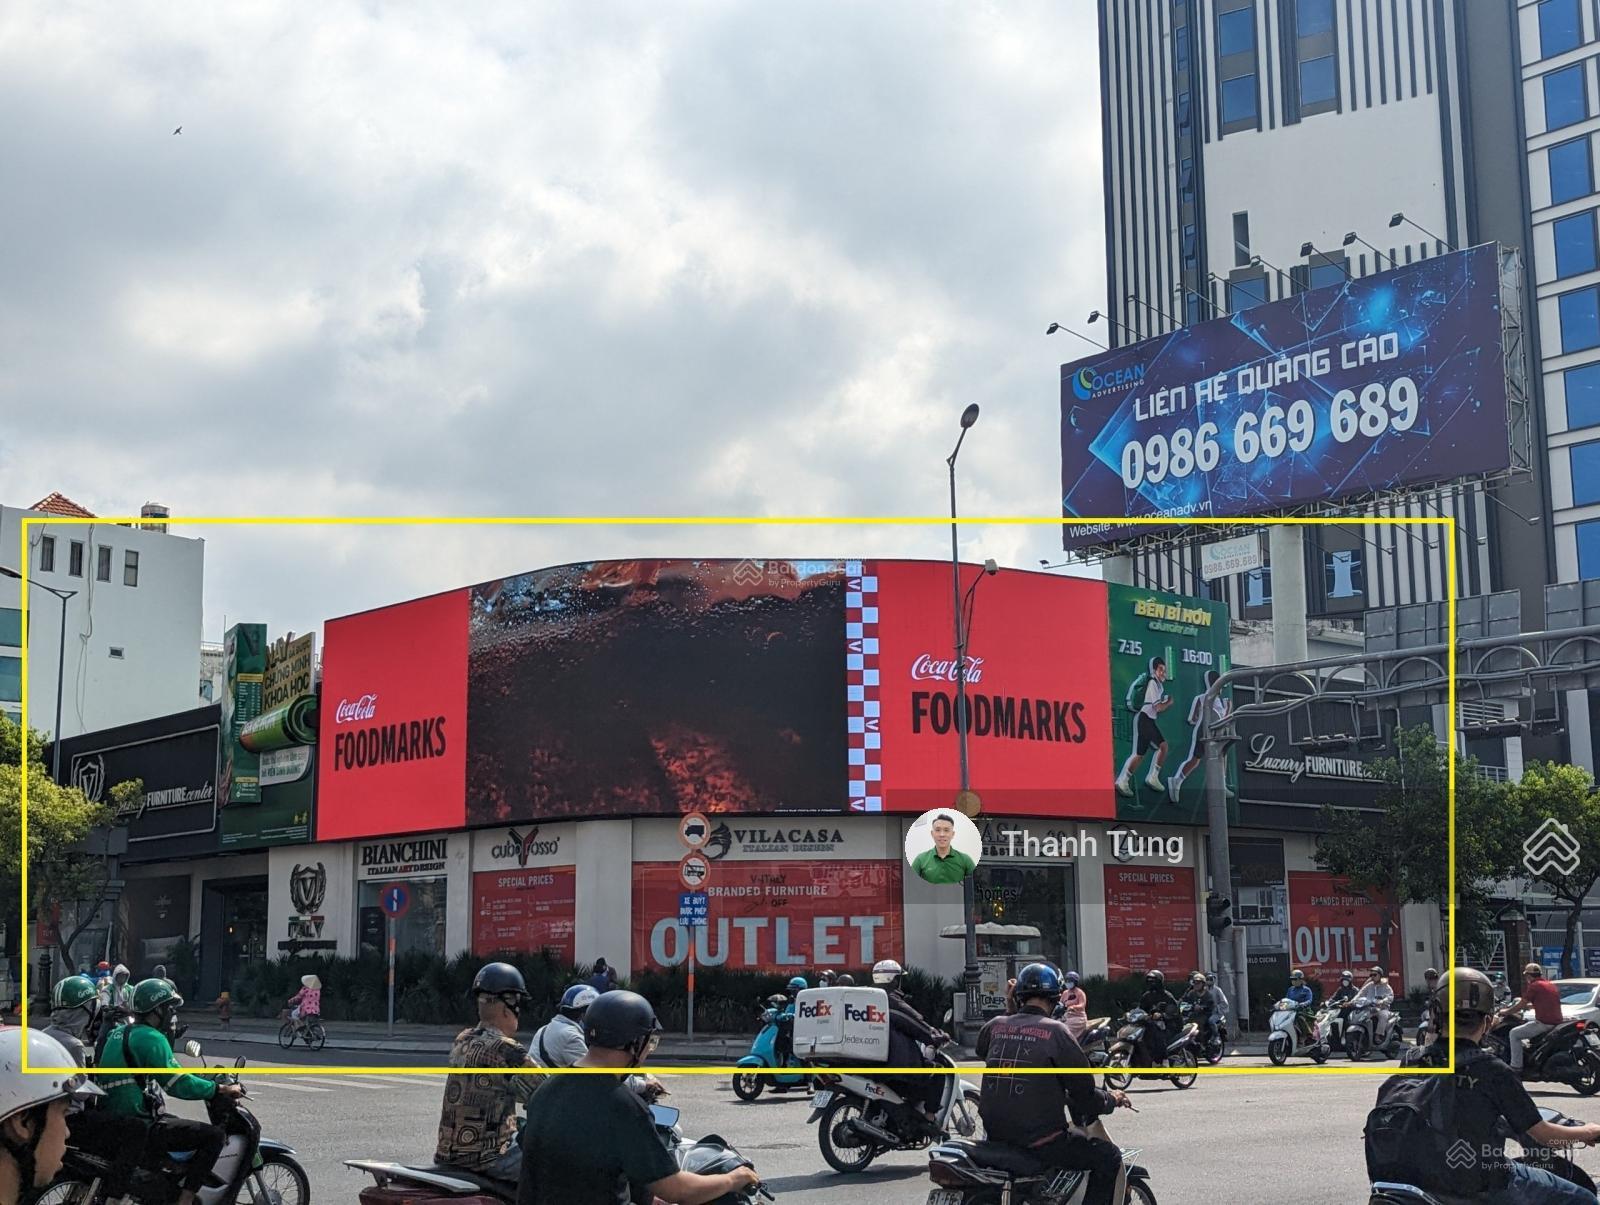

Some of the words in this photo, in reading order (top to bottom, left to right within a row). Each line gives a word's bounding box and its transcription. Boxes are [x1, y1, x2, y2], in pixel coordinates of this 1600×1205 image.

[1090, 363, 1146, 391] OCEAN
[1090, 378, 1145, 399] ADVERTISING
[1135, 383, 1188, 422] LIÊN
[1236, 347, 1331, 396] QUẢNG
[1340, 332, 1399, 371] CÁO
[1121, 422, 1221, 490] 0986
[1233, 399, 1315, 464] 669
[1330, 376, 1419, 443] 689
[1117, 638, 1142, 656] 7:15
[1182, 648, 1213, 666] 16:00
[911, 691, 1086, 744] FOODMARKS
[334, 716, 446, 772] FOODMARKS
[1245, 733, 1304, 784] Luxury
[1304, 755, 1363, 777] FURNITURE
[146, 786, 187, 808] FURNITURE
[734, 829, 844, 843] VILACASA
[361, 838, 448, 866] BIANCHINI
[498, 877, 526, 888] SPECIAL
[528, 874, 554, 886] PRICES
[1118, 872, 1147, 883] SPECIAL
[1149, 873, 1174, 883] PRICES
[708, 886, 761, 897] BRANDED
[765, 885, 828, 896] FURNITURE
[651, 915, 885, 968] OUTLET
[151, 990, 167, 1001] Grab
[798, 1000, 832, 1018] FedEx
[844, 1004, 886, 1023] FedEx
